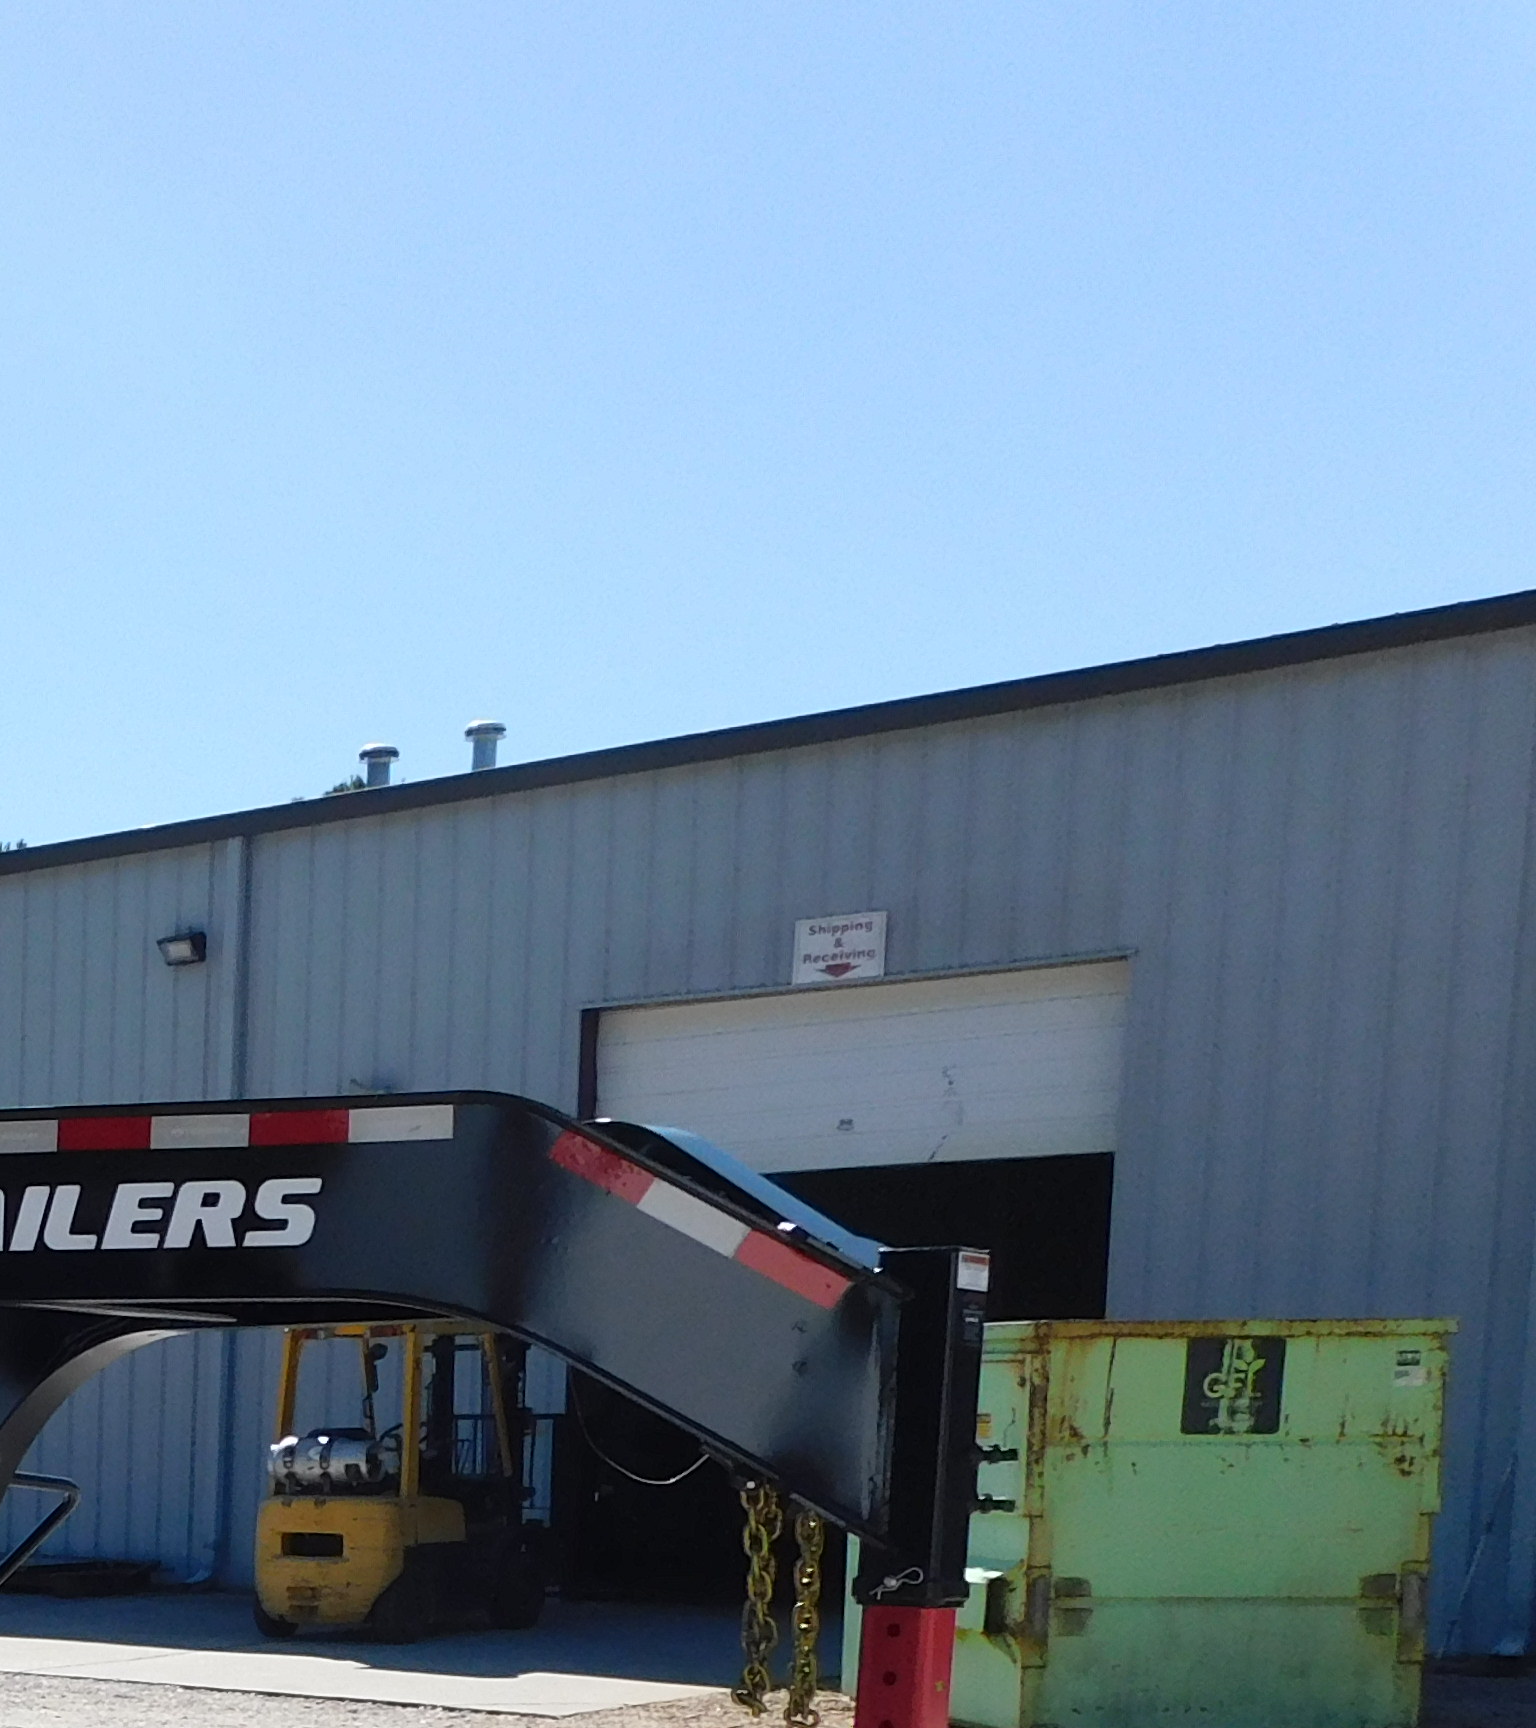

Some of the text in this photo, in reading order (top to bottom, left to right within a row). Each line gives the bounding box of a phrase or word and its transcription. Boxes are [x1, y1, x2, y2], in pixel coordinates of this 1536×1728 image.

[808, 921, 873, 937] Shipping
[834, 937, 844, 949] &
[803, 949, 877, 965] Receiving
